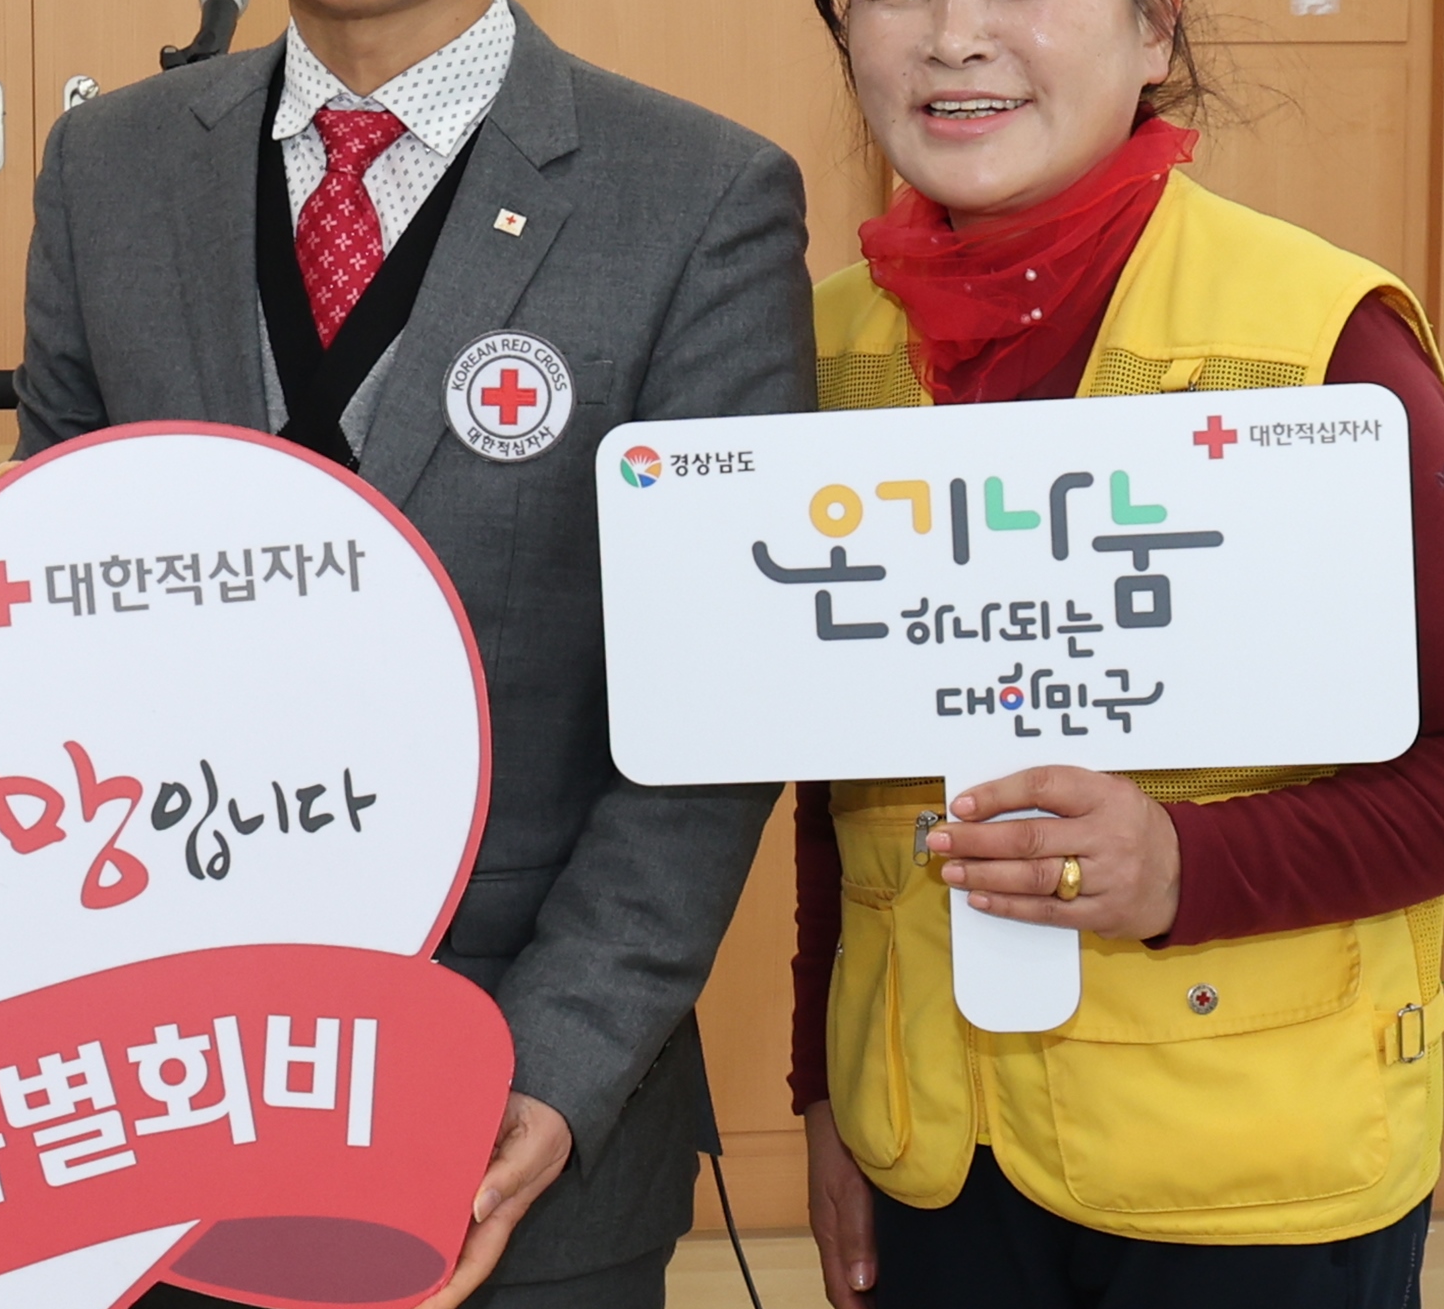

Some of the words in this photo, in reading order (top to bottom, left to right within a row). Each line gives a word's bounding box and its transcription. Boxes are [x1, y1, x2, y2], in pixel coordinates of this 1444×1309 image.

[451, 342, 498, 392] KOREAN
[501, 339, 532, 355] RED
[534, 347, 568, 392] CROSS
[466, 425, 556, 457] 대한적십자사
[1248, 418, 1384, 448] 대한적십자사
[669, 450, 757, 478] 경상남도
[44, 539, 367, 618] 대한적십자사
[752, 470, 1226, 642] 온기나눔
[900, 596, 1105, 659] 하나되는
[935, 662, 1166, 739] 대한민국
